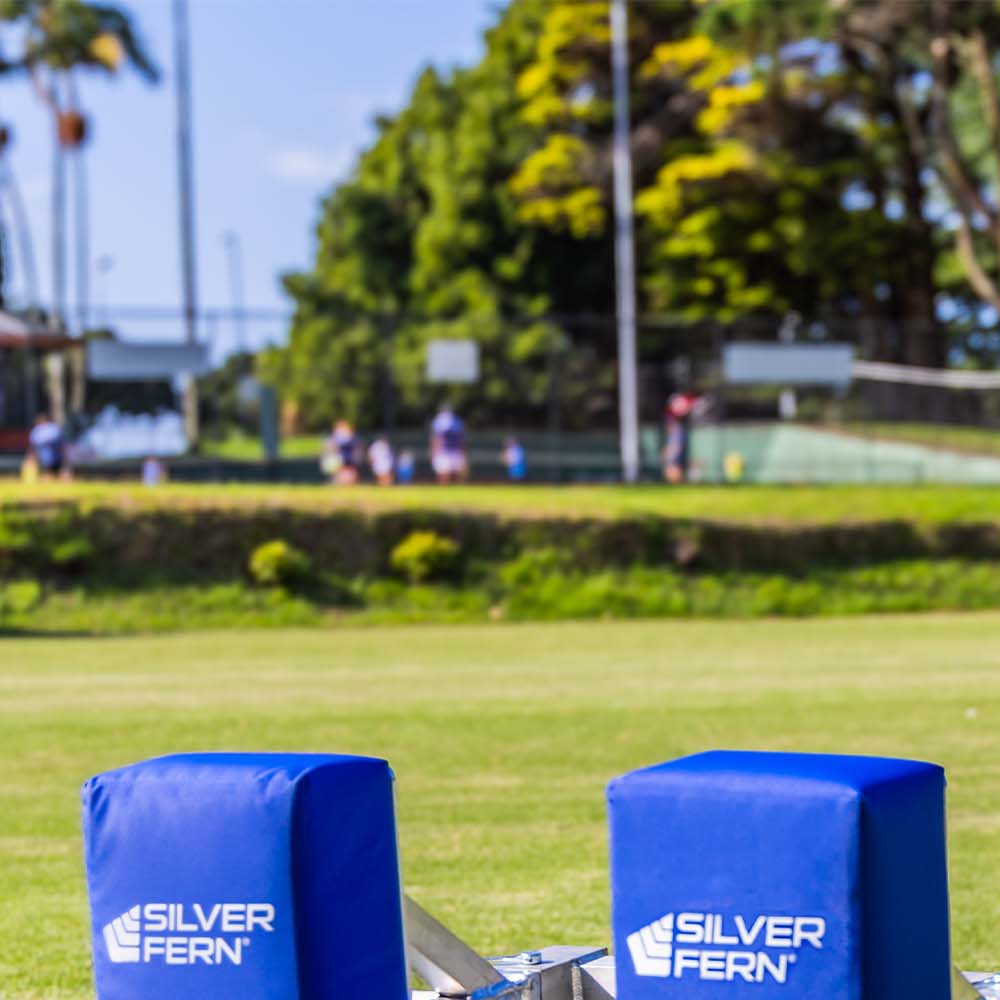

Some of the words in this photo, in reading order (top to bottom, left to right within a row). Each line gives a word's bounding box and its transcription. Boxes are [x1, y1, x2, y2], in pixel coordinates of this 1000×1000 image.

[144, 903, 275, 932] SILVER
[676, 912, 826, 949] SILVER
[144, 936, 242, 965] FERN
[673, 949, 788, 983] FERN
